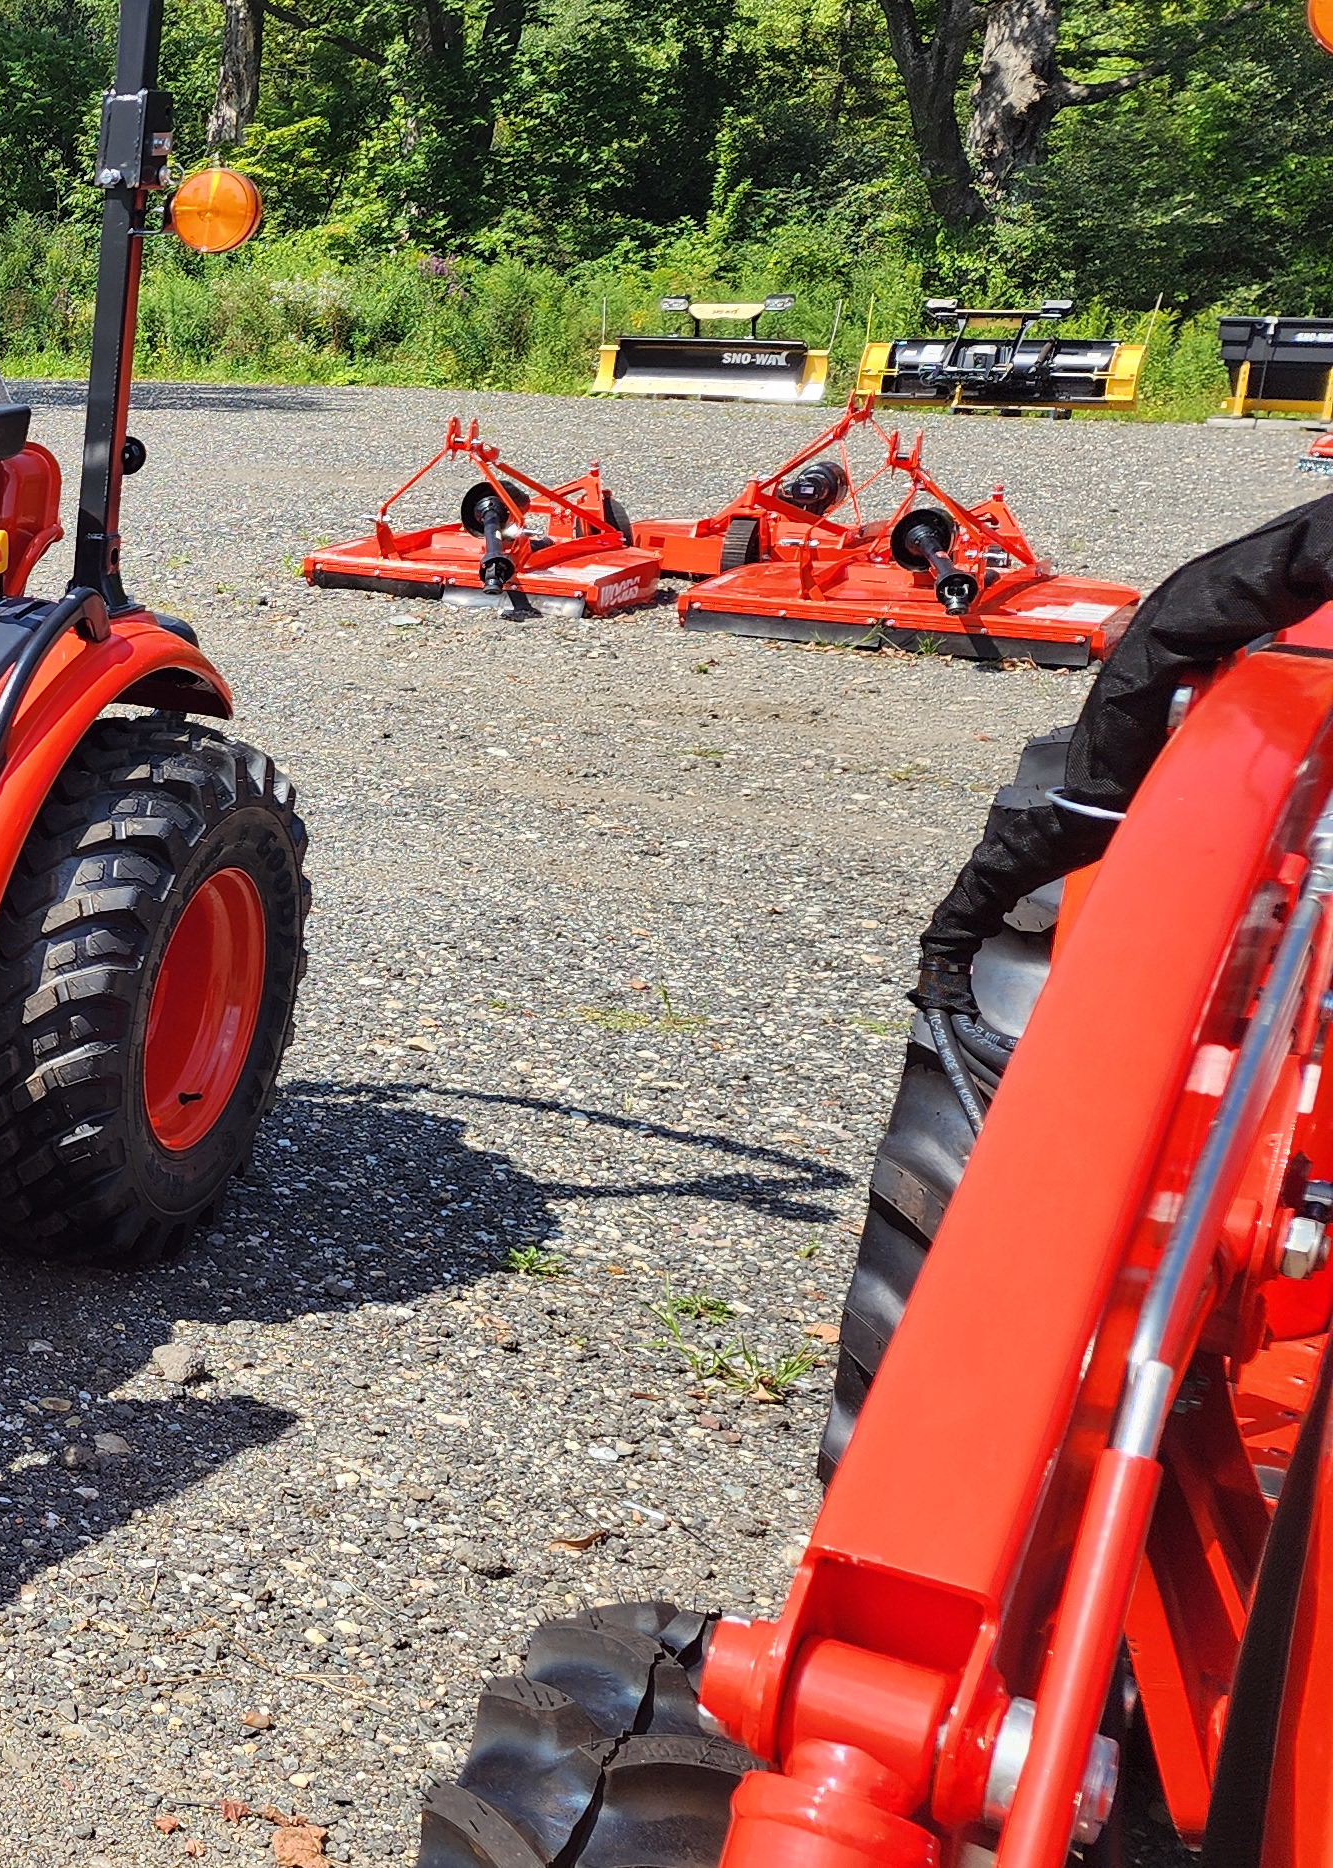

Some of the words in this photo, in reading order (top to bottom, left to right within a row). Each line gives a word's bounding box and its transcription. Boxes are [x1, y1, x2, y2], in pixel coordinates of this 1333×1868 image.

[722, 350, 790, 366] SNO-WAY
[600, 576, 641, 608] WOODS
[952, 1073, 965, 1087] IN
[959, 1087, 981, 1120] KOREA
